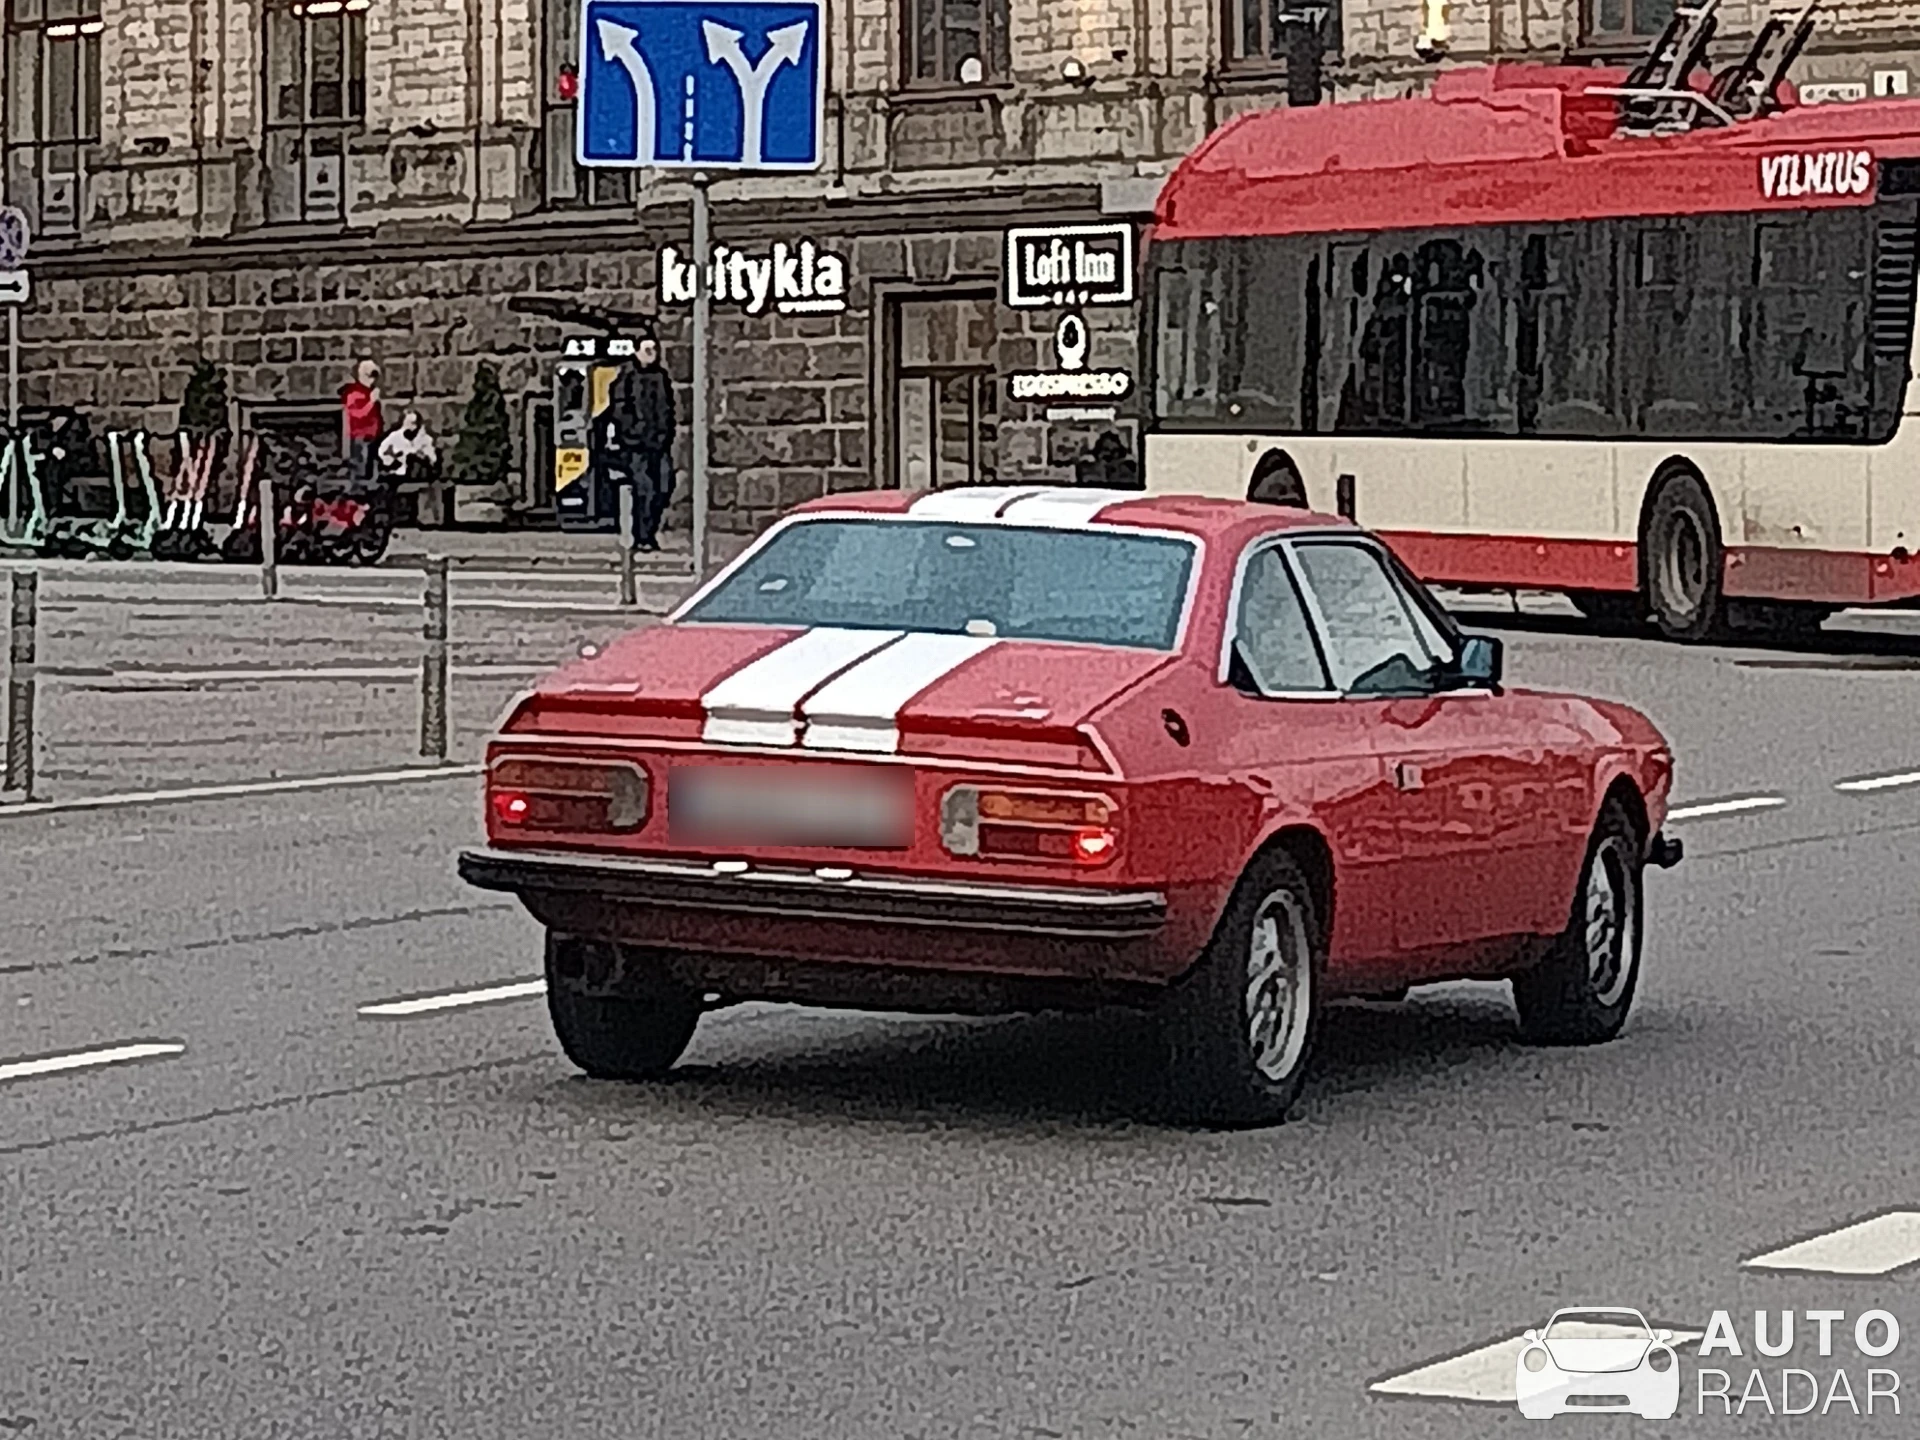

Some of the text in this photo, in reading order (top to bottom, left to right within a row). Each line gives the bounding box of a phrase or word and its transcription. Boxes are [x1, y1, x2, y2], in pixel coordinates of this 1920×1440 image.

[1762, 150, 1871, 198] VILNIUS
[1025, 238, 1115, 285] Loft Inn
